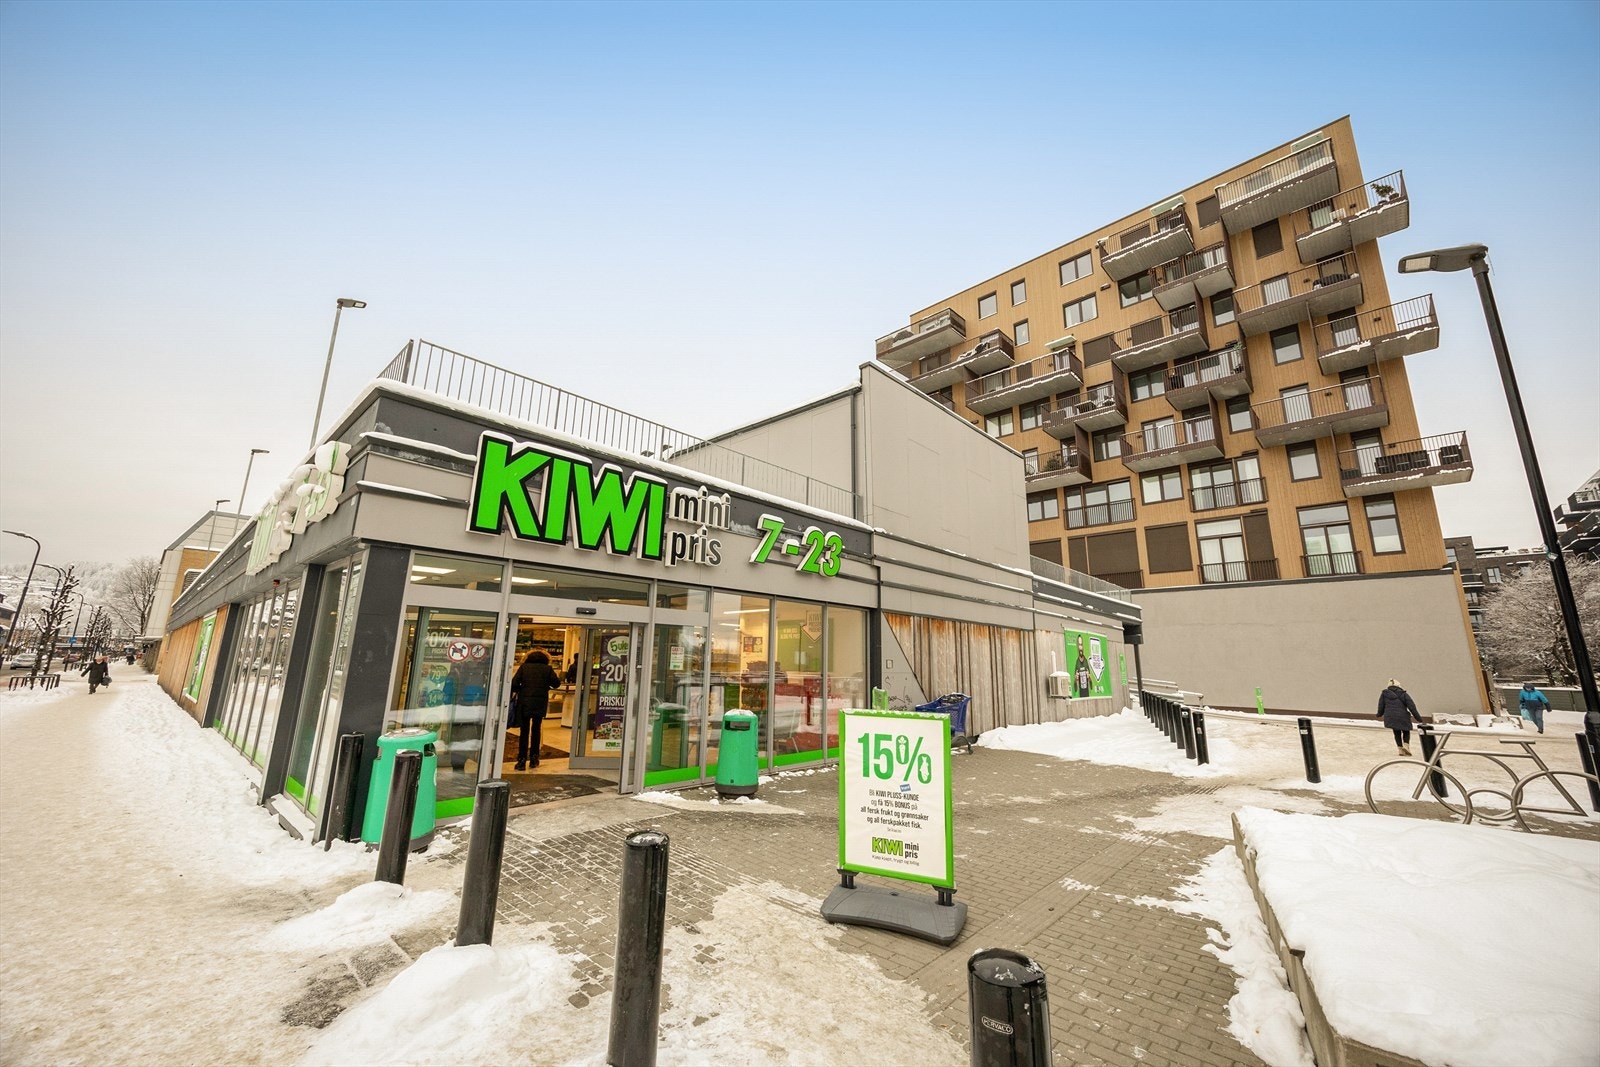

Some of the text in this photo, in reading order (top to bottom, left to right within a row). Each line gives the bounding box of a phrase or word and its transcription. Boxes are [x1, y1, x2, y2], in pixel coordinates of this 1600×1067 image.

[468, 432, 668, 561] KIWI
[671, 488, 732, 529] mini
[667, 527, 722, 566] pris
[858, 732, 932, 784] 15%
[887, 791, 920, 801] PLUSS-KUNDE
[895, 801, 910, 809] BONUS
[881, 808, 893, 816] frukt
[901, 812, 929, 821] grønnsaker
[881, 818, 910, 828] ferskpakket
[872, 836, 903, 856] KIWI
[905, 842, 919, 851] mini
[905, 850, 918, 858] pris
